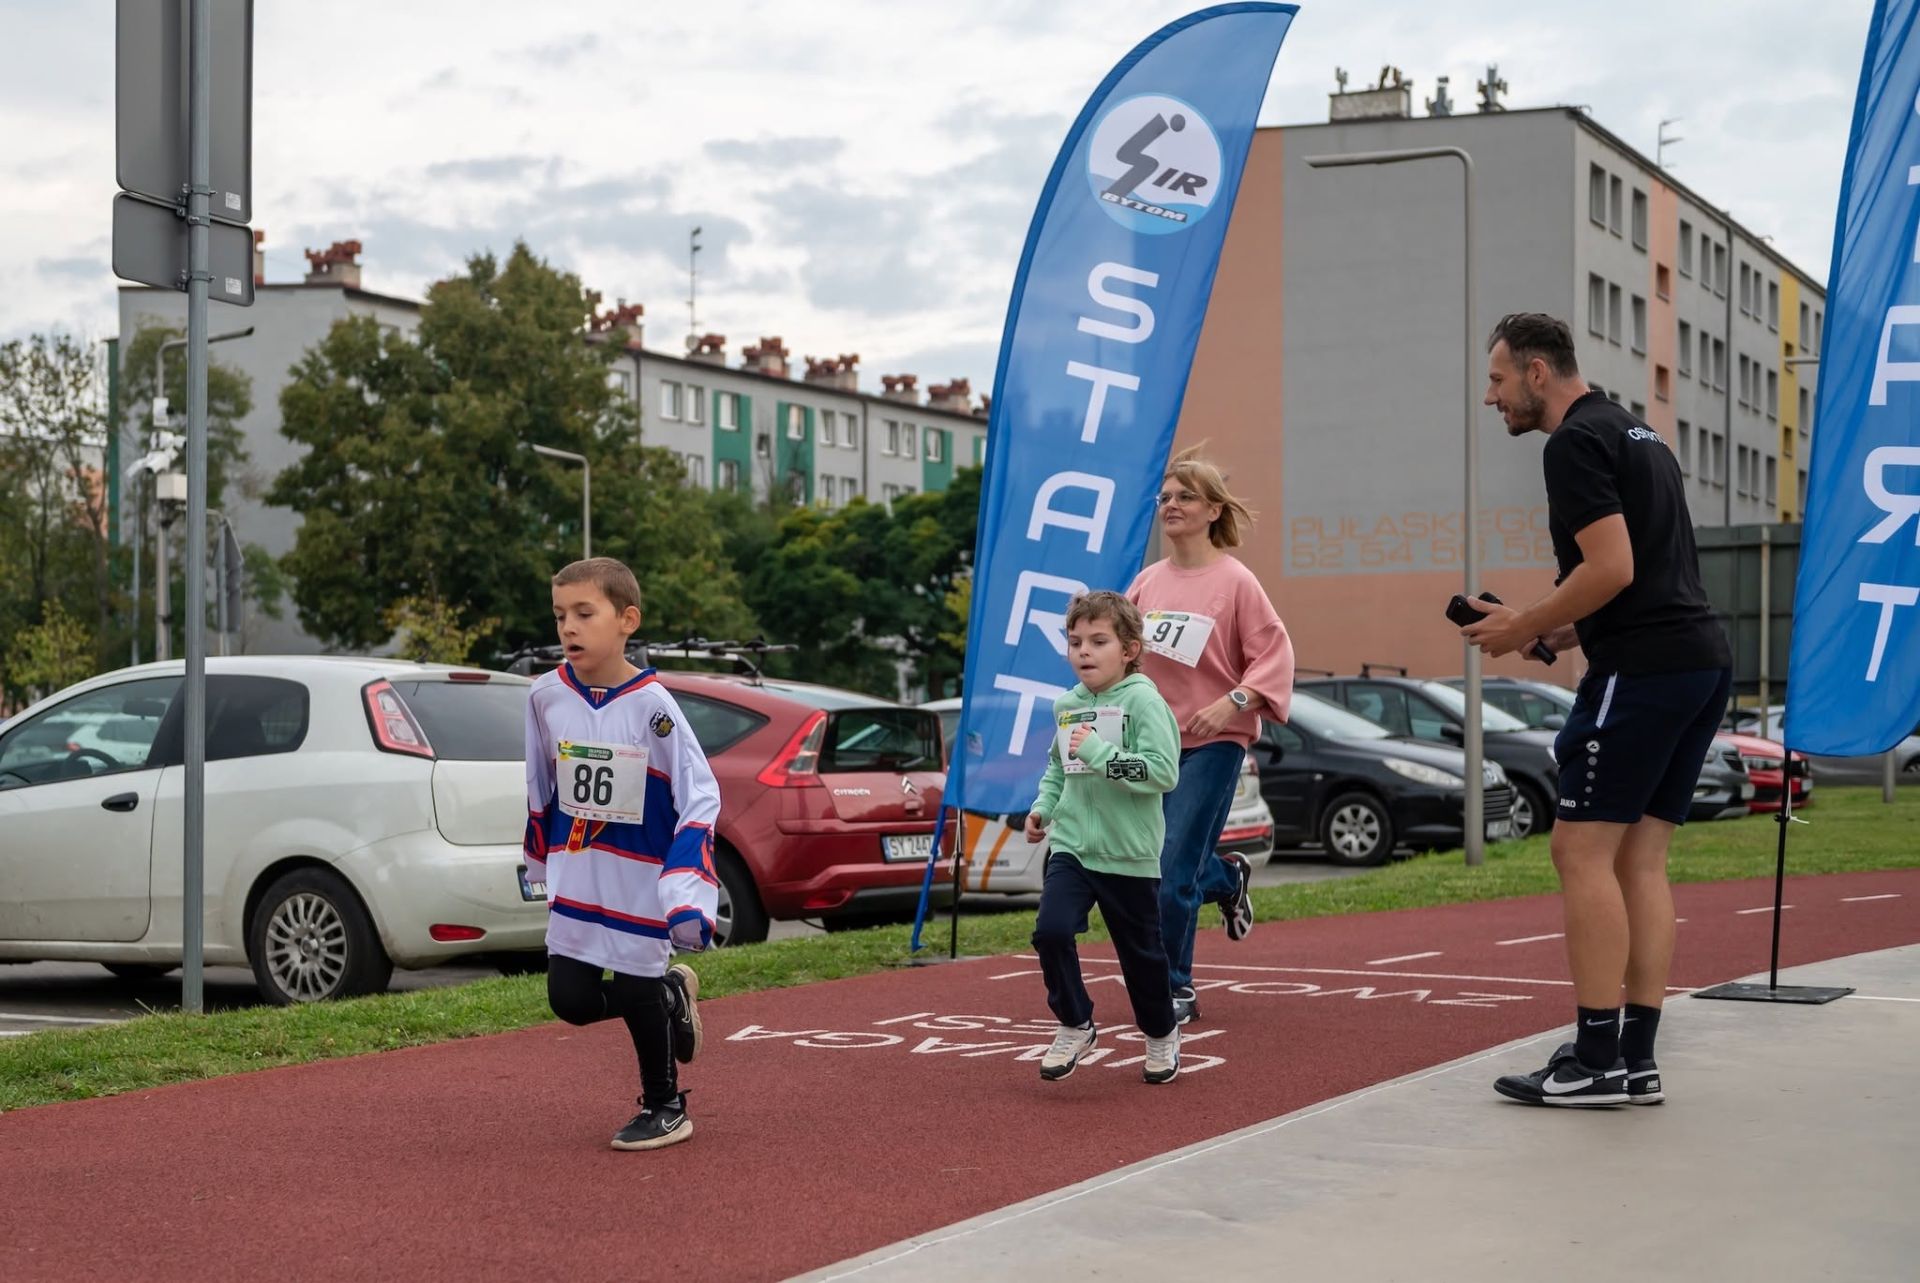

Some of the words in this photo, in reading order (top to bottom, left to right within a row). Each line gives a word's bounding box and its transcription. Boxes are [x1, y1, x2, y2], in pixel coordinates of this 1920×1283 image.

[1101, 192, 1187, 221] BYTOM
[994, 262, 1160, 756] START
[1152, 621, 1186, 649] 91
[573, 763, 614, 806] 86
[890, 837, 905, 856] SY
